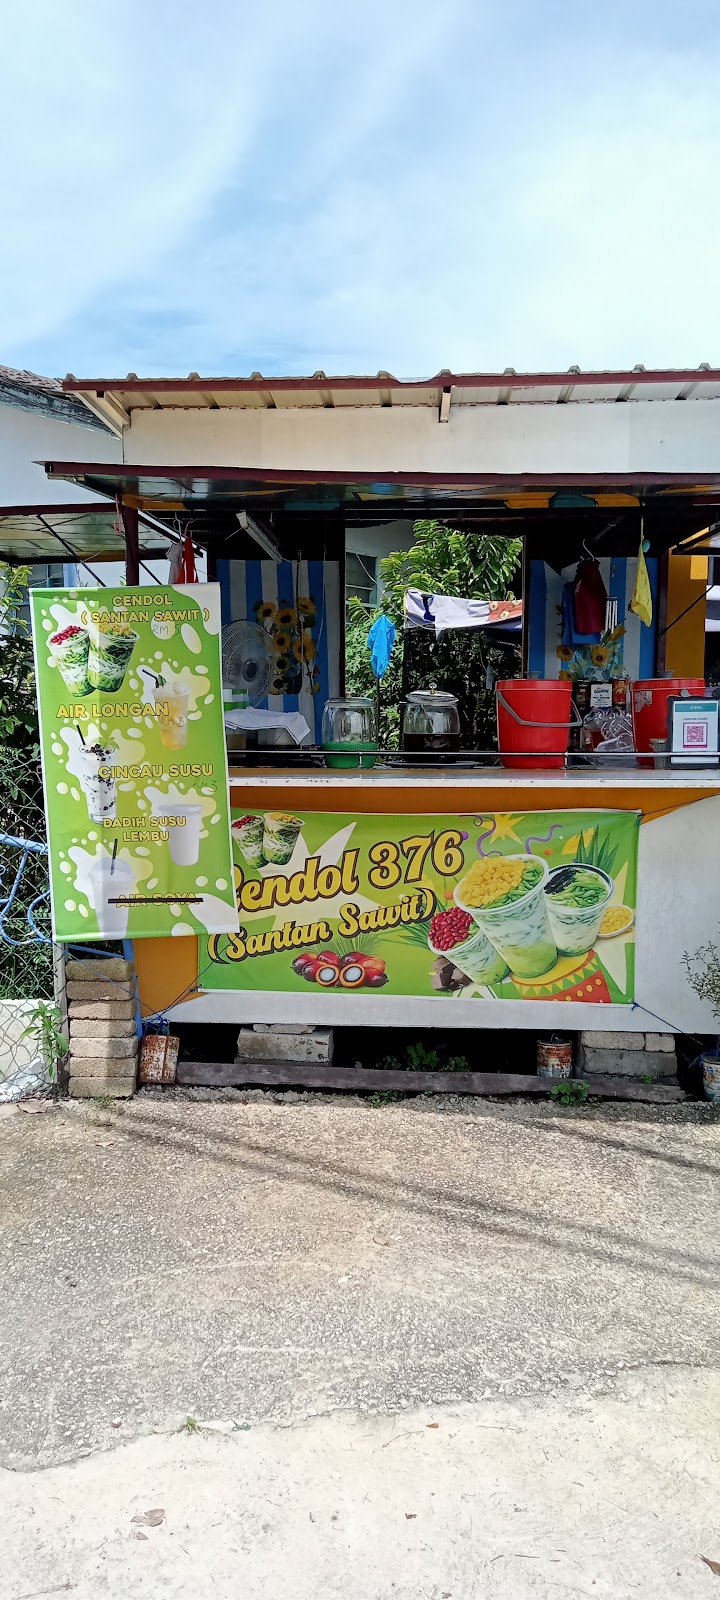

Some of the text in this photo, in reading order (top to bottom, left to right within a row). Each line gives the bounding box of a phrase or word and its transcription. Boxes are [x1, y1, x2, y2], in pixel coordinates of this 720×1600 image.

[112, 593, 173, 607] CENDOL
[91, 610, 150, 624] SANTAN
[153, 609, 200, 623] SAWIT
[152, 623, 169, 636] RM
[56, 702, 170, 719] AIR LONGAN
[98, 763, 214, 778] CINCAU SUSU
[102, 815, 187, 828] DADIH SUSU
[122, 830, 170, 842] LEMBU
[368, 829, 465, 890] 376
[337, 887, 436, 938] Sawit)
